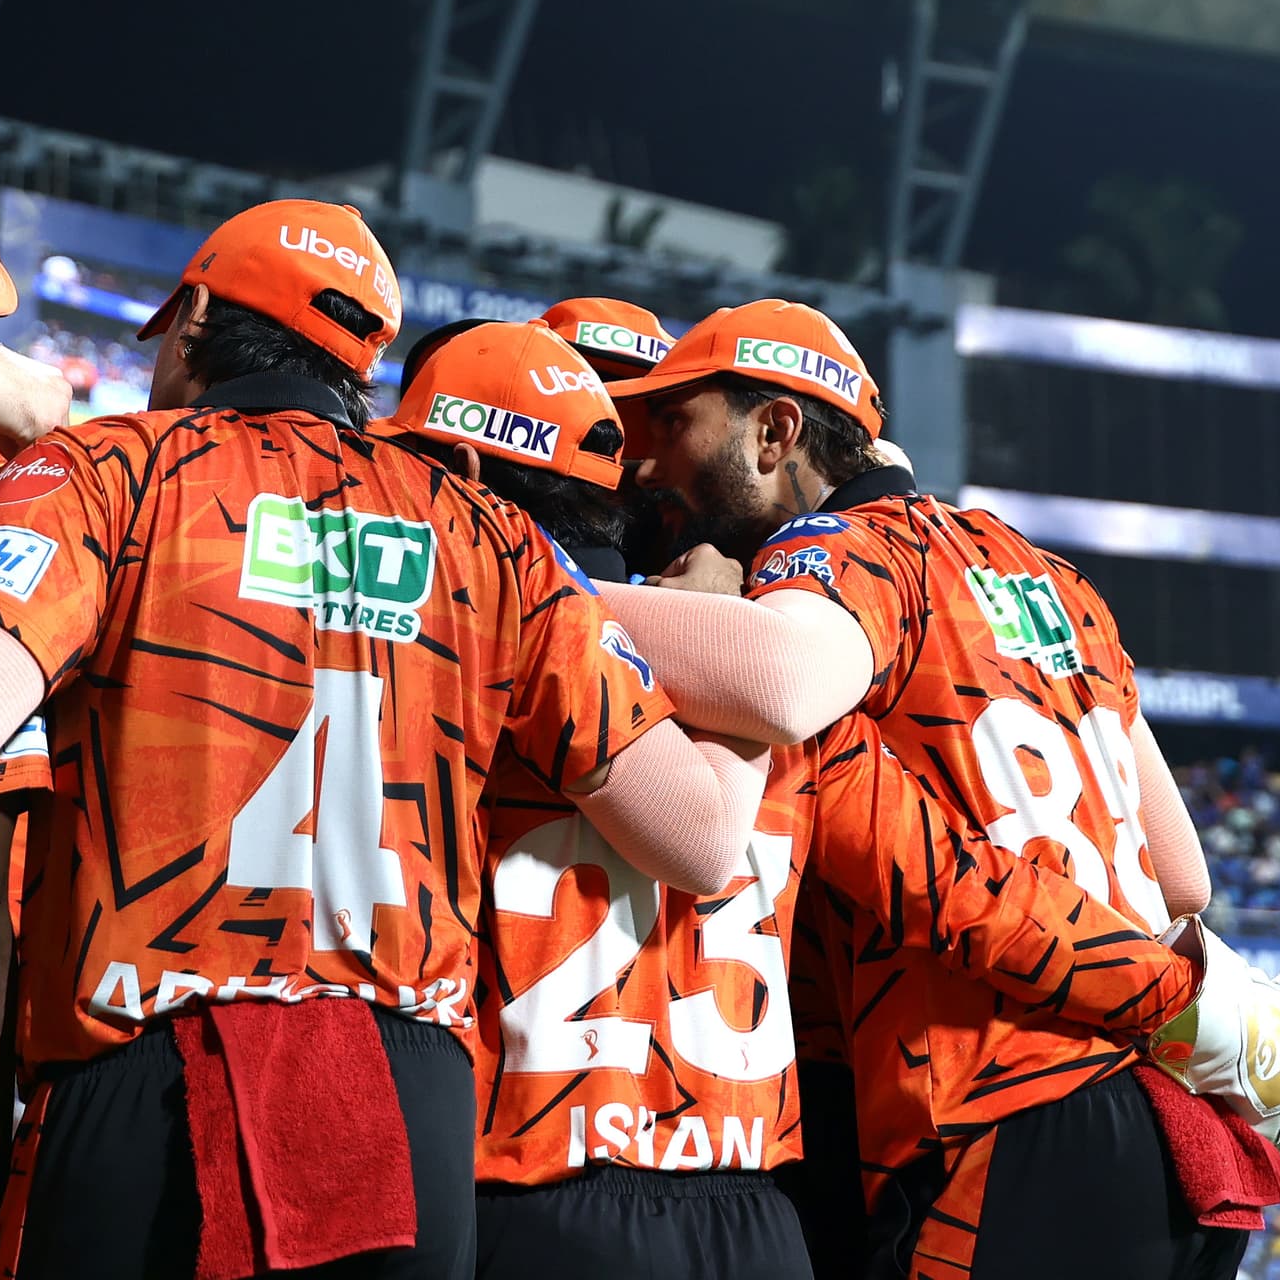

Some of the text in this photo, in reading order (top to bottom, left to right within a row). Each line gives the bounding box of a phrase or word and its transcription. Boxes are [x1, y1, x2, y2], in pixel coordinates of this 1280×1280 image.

[200, 252, 217, 273] 4
[280, 225, 370, 276] Uber
[578, 323, 671, 361] ECOLIN
[738, 339, 859, 399] ECOLINK
[529, 366, 602, 396] Ube
[427, 396, 558, 455] ECOLINK
[253, 508, 428, 590] BKT
[322, 600, 415, 637] TYRES
[226, 668, 406, 951] 4
[493, 815, 796, 1082] 23
